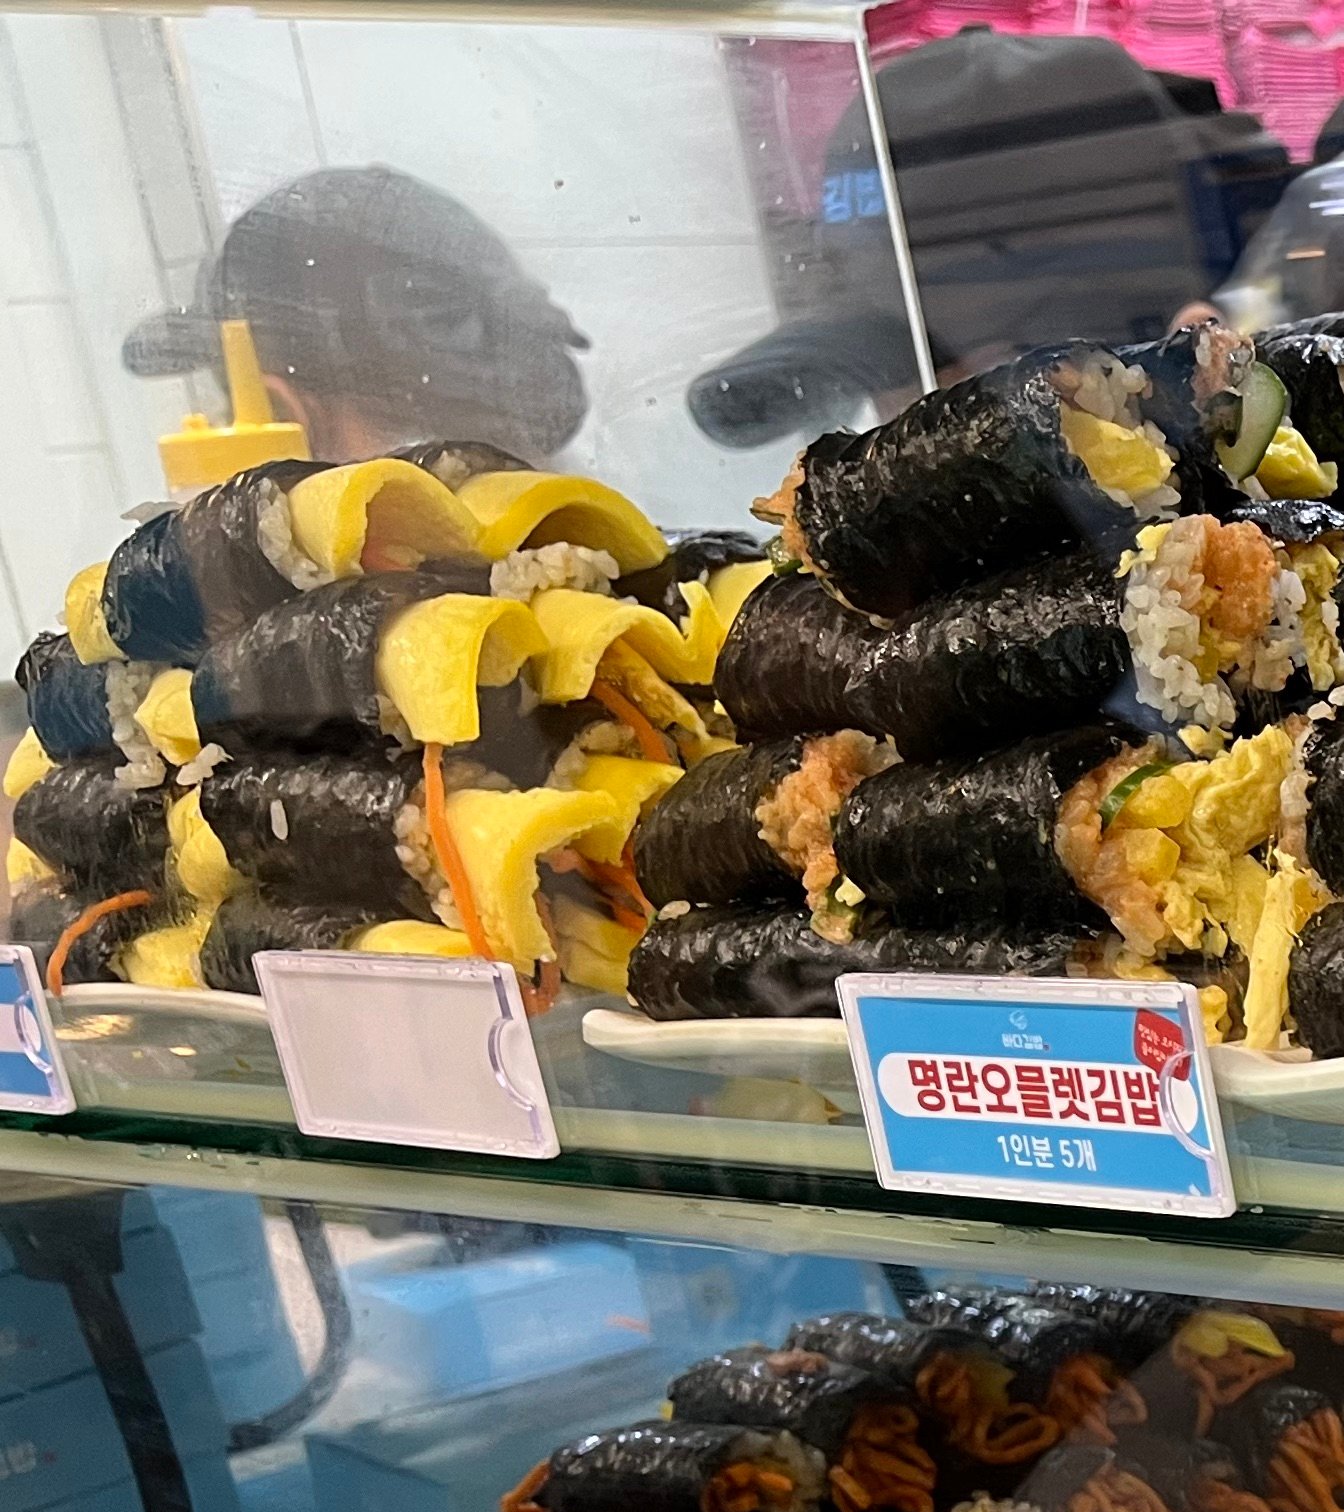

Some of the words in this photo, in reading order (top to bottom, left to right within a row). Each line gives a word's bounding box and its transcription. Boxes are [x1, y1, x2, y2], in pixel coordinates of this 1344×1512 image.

[907, 1059, 1162, 1128] 명란오믈렛김밥
[996, 1135, 1056, 1169] 1인분
[1060, 1140, 1097, 1172] 5개
